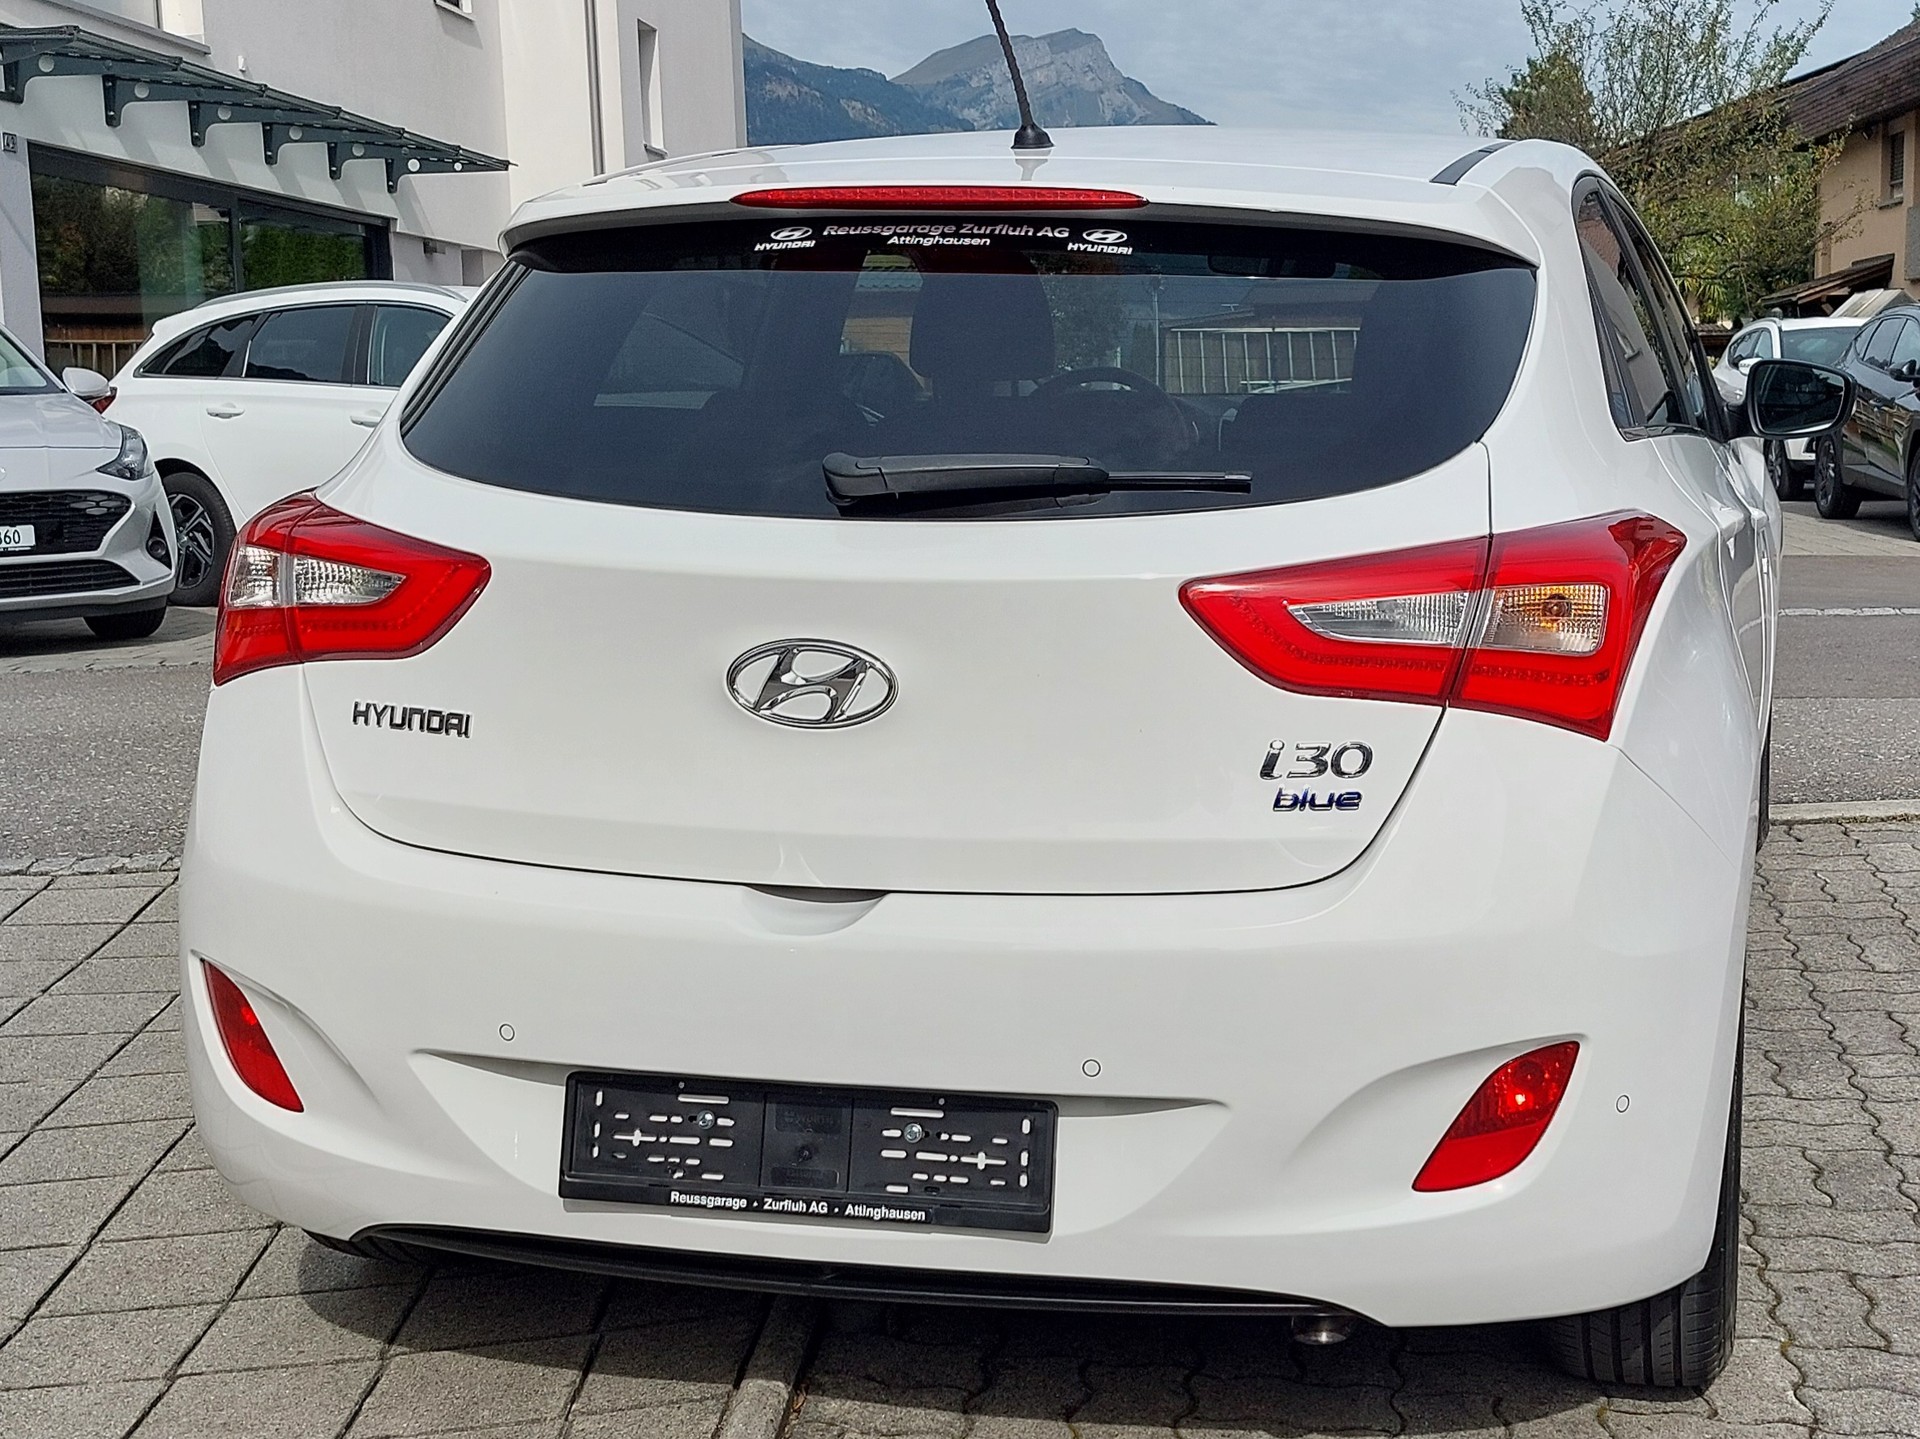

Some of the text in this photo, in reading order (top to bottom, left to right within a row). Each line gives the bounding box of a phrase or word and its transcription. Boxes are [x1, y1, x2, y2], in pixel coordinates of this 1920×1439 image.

[822, 223, 1070, 238] Reussgarage Zurfluh AG
[886, 235, 991, 247] Attinghausen
[754, 239, 816, 251] HYUNDAI
[1067, 242, 1133, 255] HYUNDAI
[352, 700, 471, 739] HYUNDAI
[1259, 739, 1374, 780] i30
[1272, 785, 1363, 812] blue
[670, 1190, 926, 1221] Reussgarage Zurfluh AG Attinghausen
